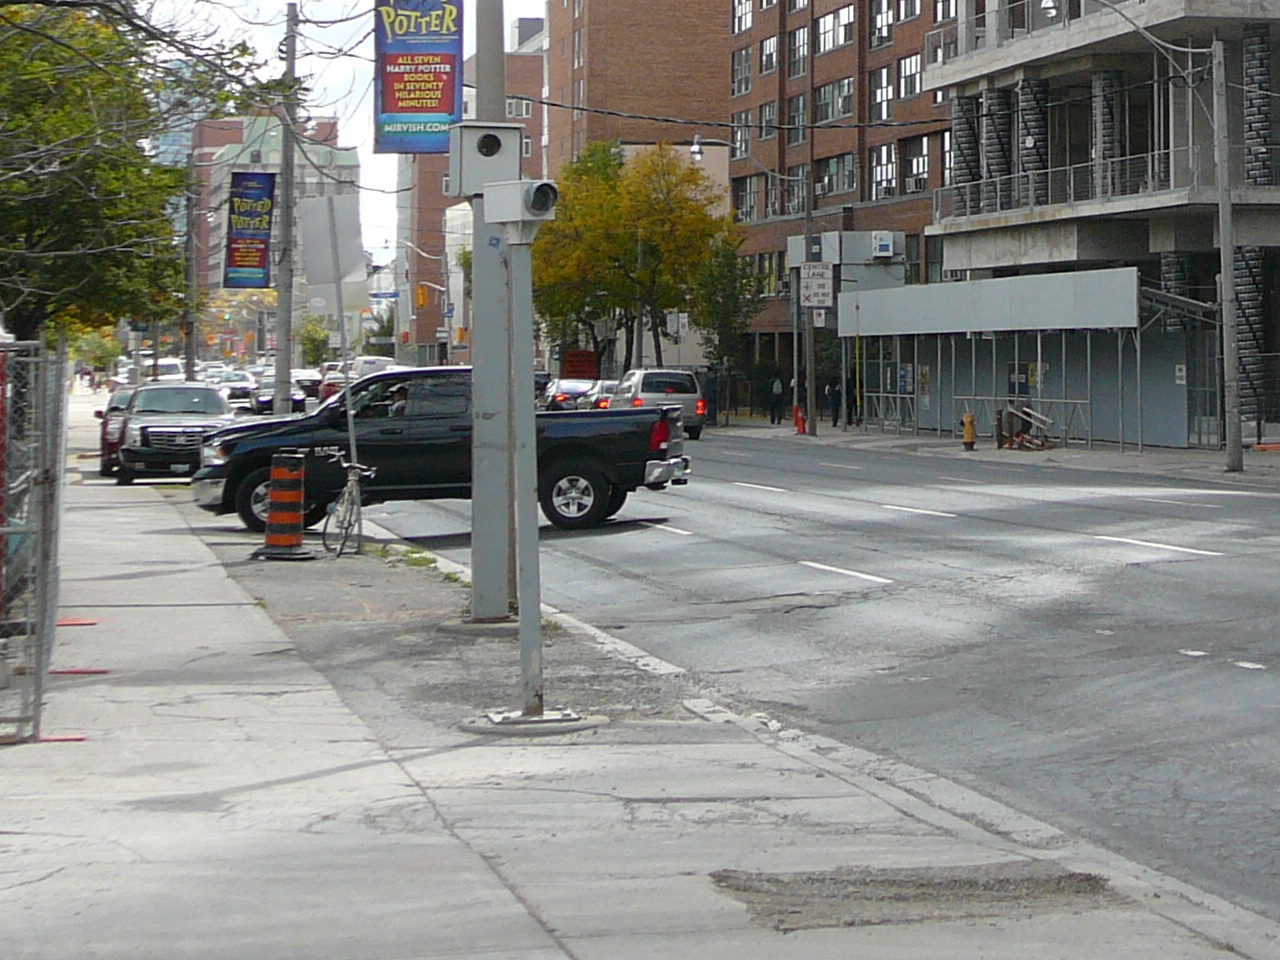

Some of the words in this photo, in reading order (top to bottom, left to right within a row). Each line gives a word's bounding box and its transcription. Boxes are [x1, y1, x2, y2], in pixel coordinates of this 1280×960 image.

[377, 4, 459, 41] POTTER
[396, 55, 413, 64] ALL
[414, 55, 441, 64] SEVEN
[386, 64, 417, 73] HARRY
[417, 64, 451, 73] POTTER
[403, 73, 434, 82] BOOKS
[406, 82, 444, 91] SEVENTY
[395, 90, 442, 99] HILARIOUS
[233, 197, 272, 214] POTTED
[230, 214, 270, 233] POTTER
[803, 263, 830, 271] CENTRE
[807, 271, 825, 279] LANE
